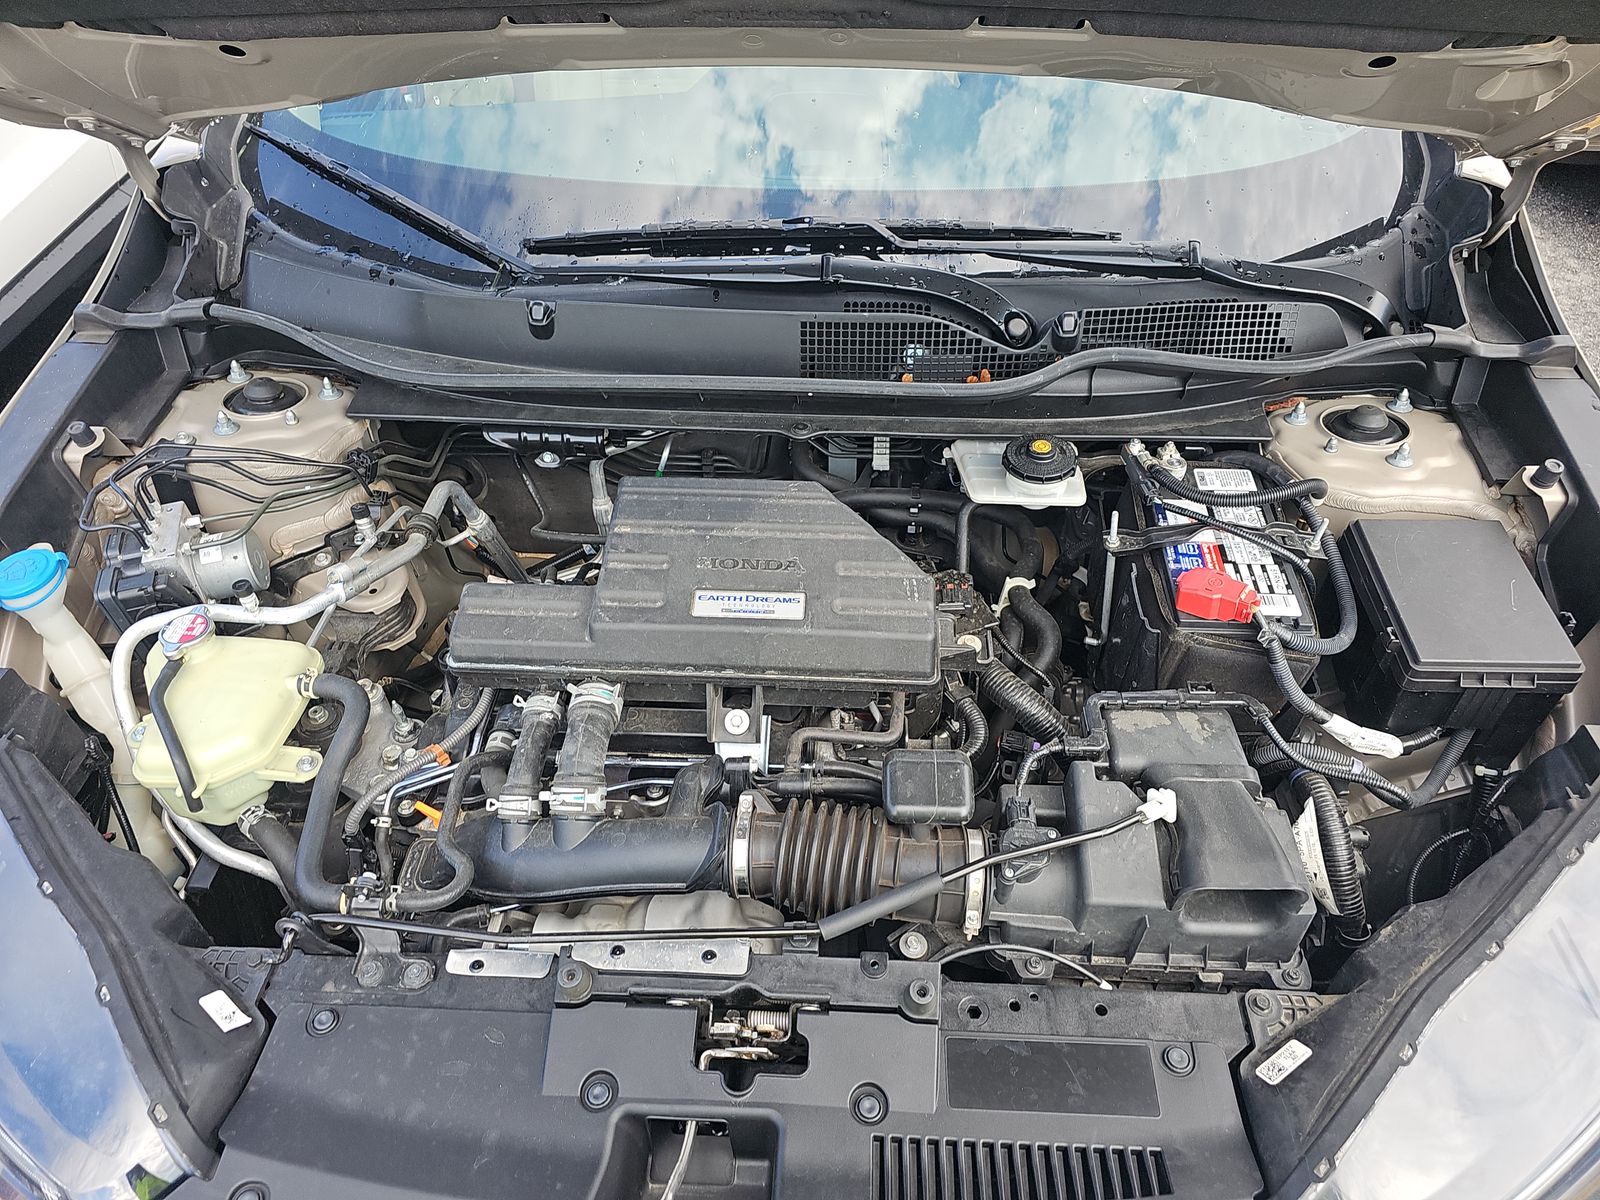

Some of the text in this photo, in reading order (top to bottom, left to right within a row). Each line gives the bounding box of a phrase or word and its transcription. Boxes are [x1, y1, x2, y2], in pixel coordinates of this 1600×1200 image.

[697, 557, 806, 574] HONDA
[698, 594, 801, 604] EARTH DREAMS
